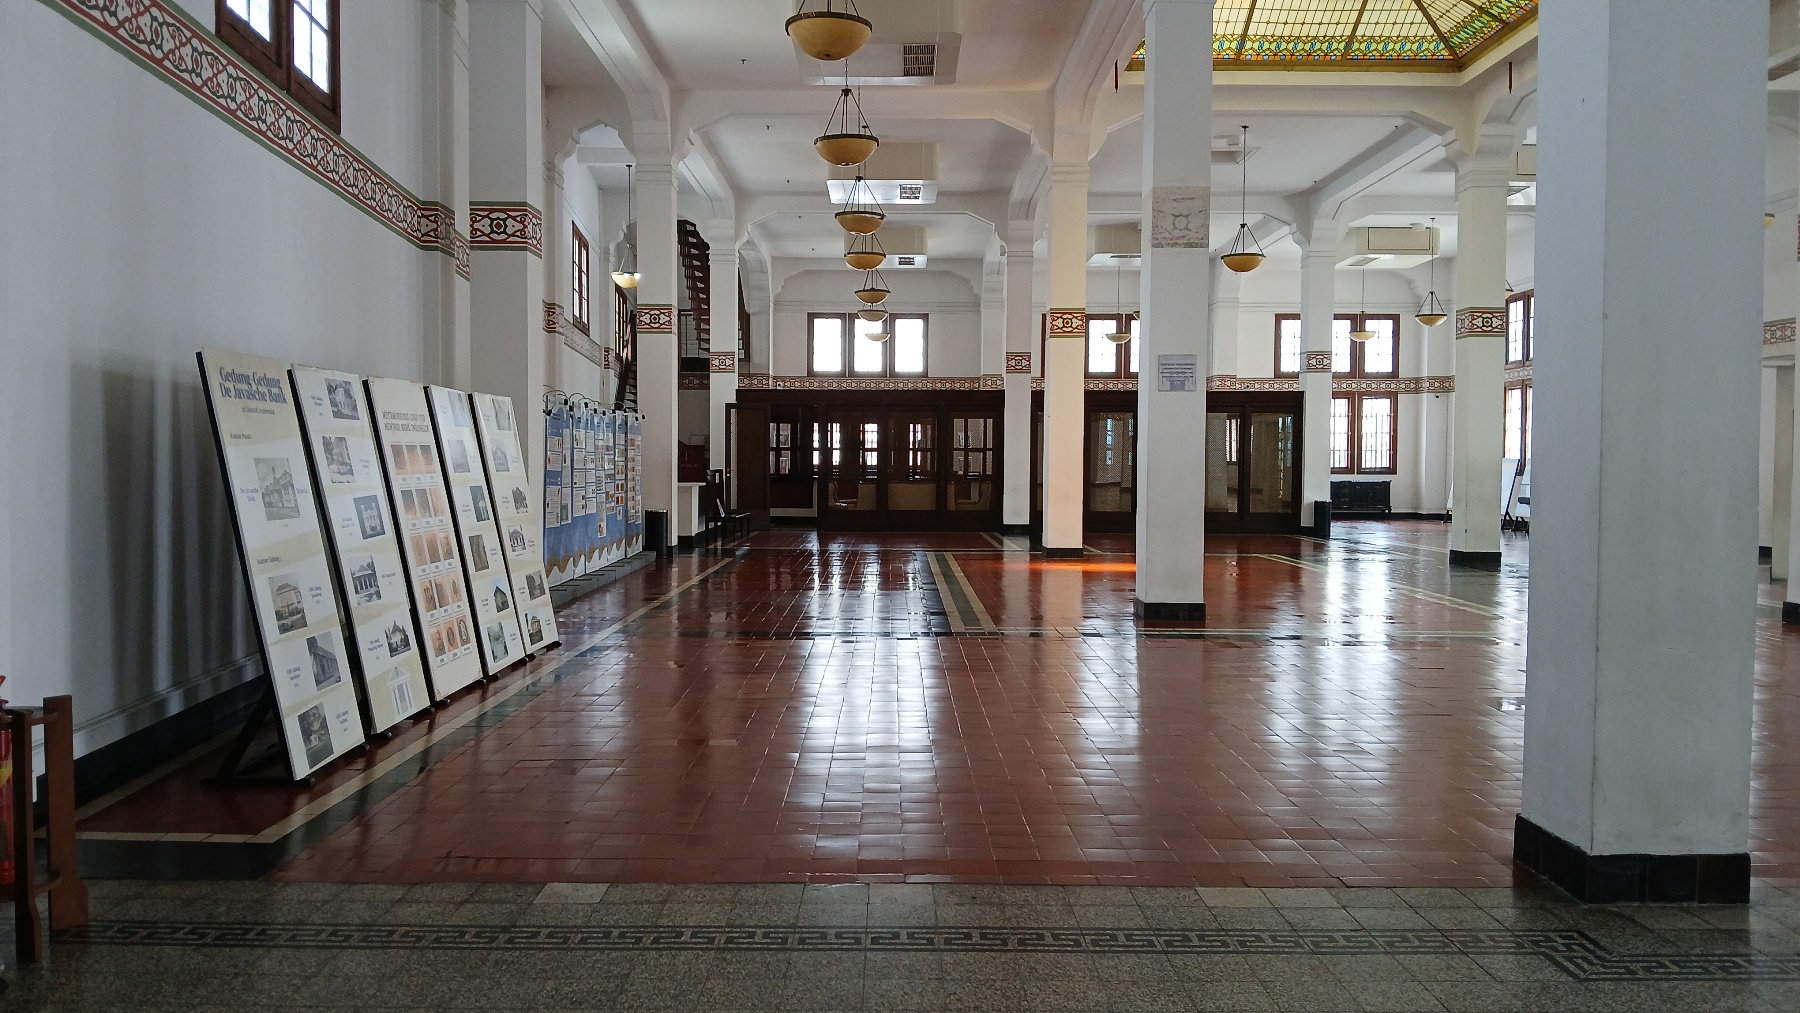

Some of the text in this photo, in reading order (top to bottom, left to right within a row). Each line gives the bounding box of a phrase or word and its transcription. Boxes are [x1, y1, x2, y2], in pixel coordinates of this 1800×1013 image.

[219, 366, 281, 389] Gedung-Gedung
[219, 382, 288, 404] De Javasche Bank
